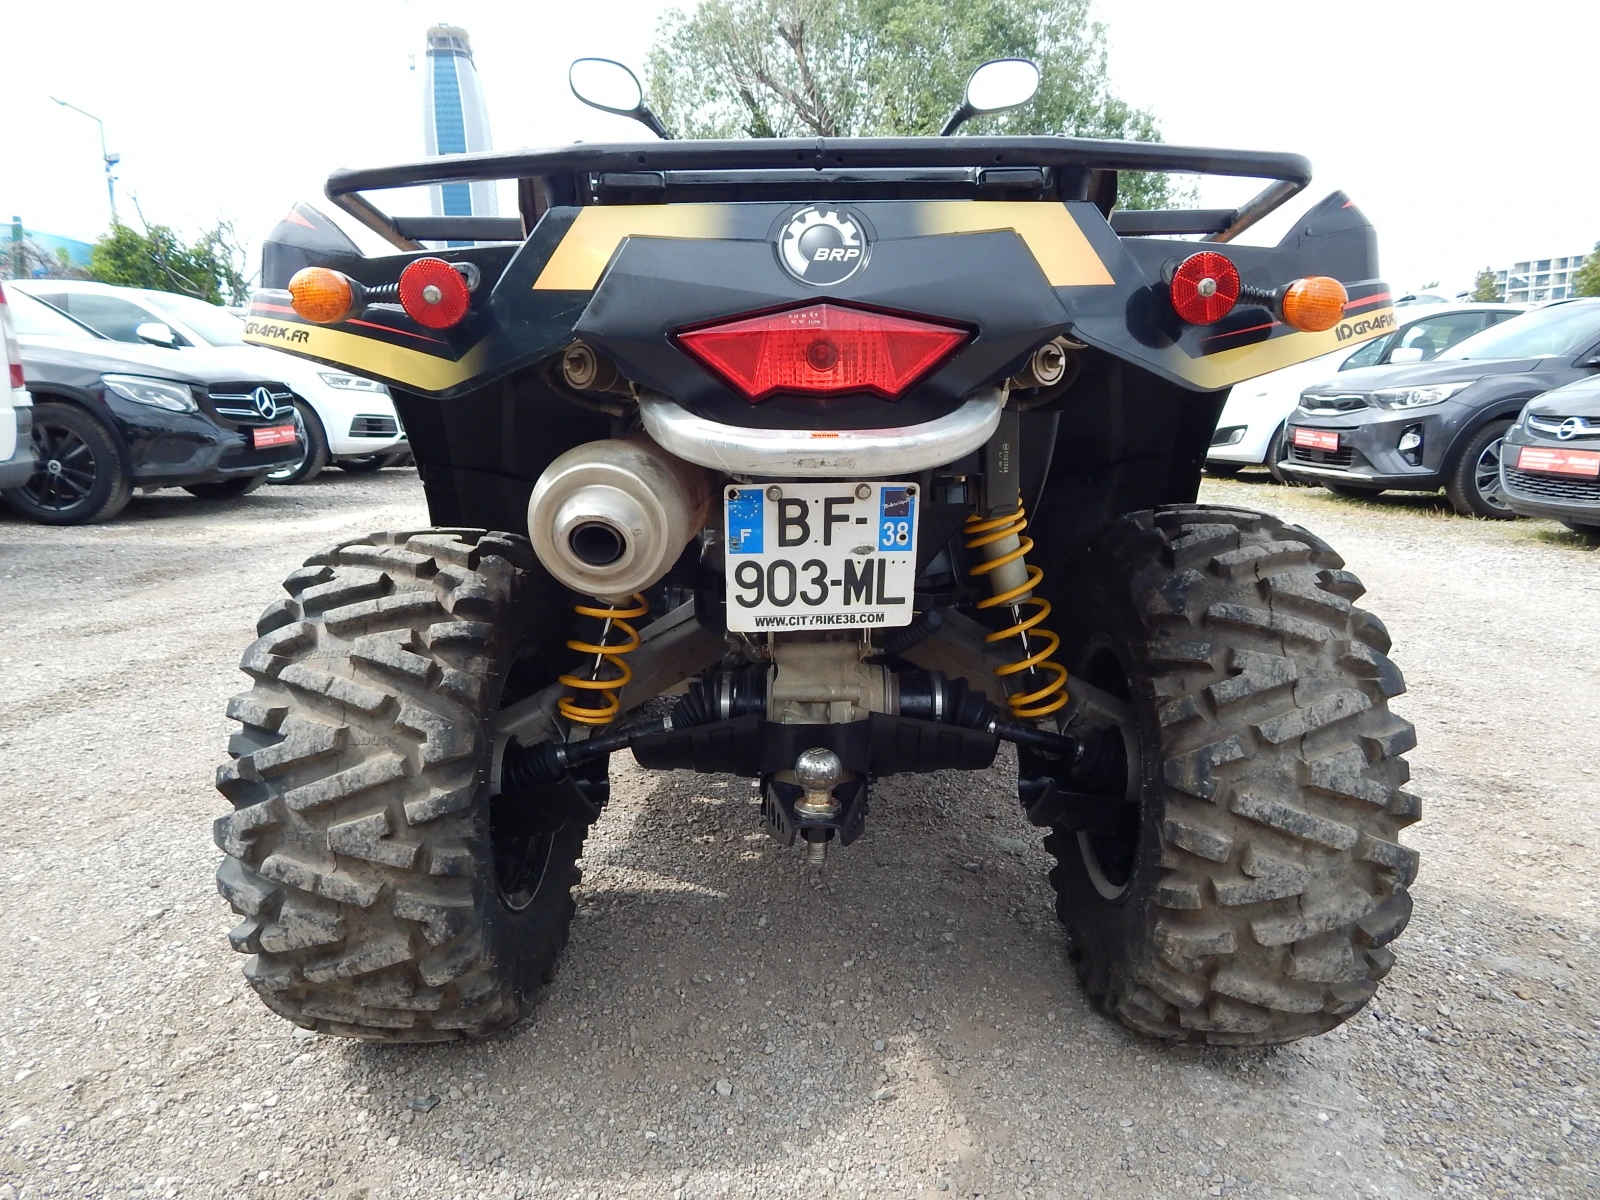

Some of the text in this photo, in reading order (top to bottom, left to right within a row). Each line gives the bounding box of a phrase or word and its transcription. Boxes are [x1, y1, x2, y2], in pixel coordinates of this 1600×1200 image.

[813, 247, 860, 262] BRP
[740, 528, 752, 543] F
[882, 521, 909, 547] 38
[735, 558, 906, 608] 903-ML
[755, 613, 885, 627] WWW.CITYBIKE38.COM
